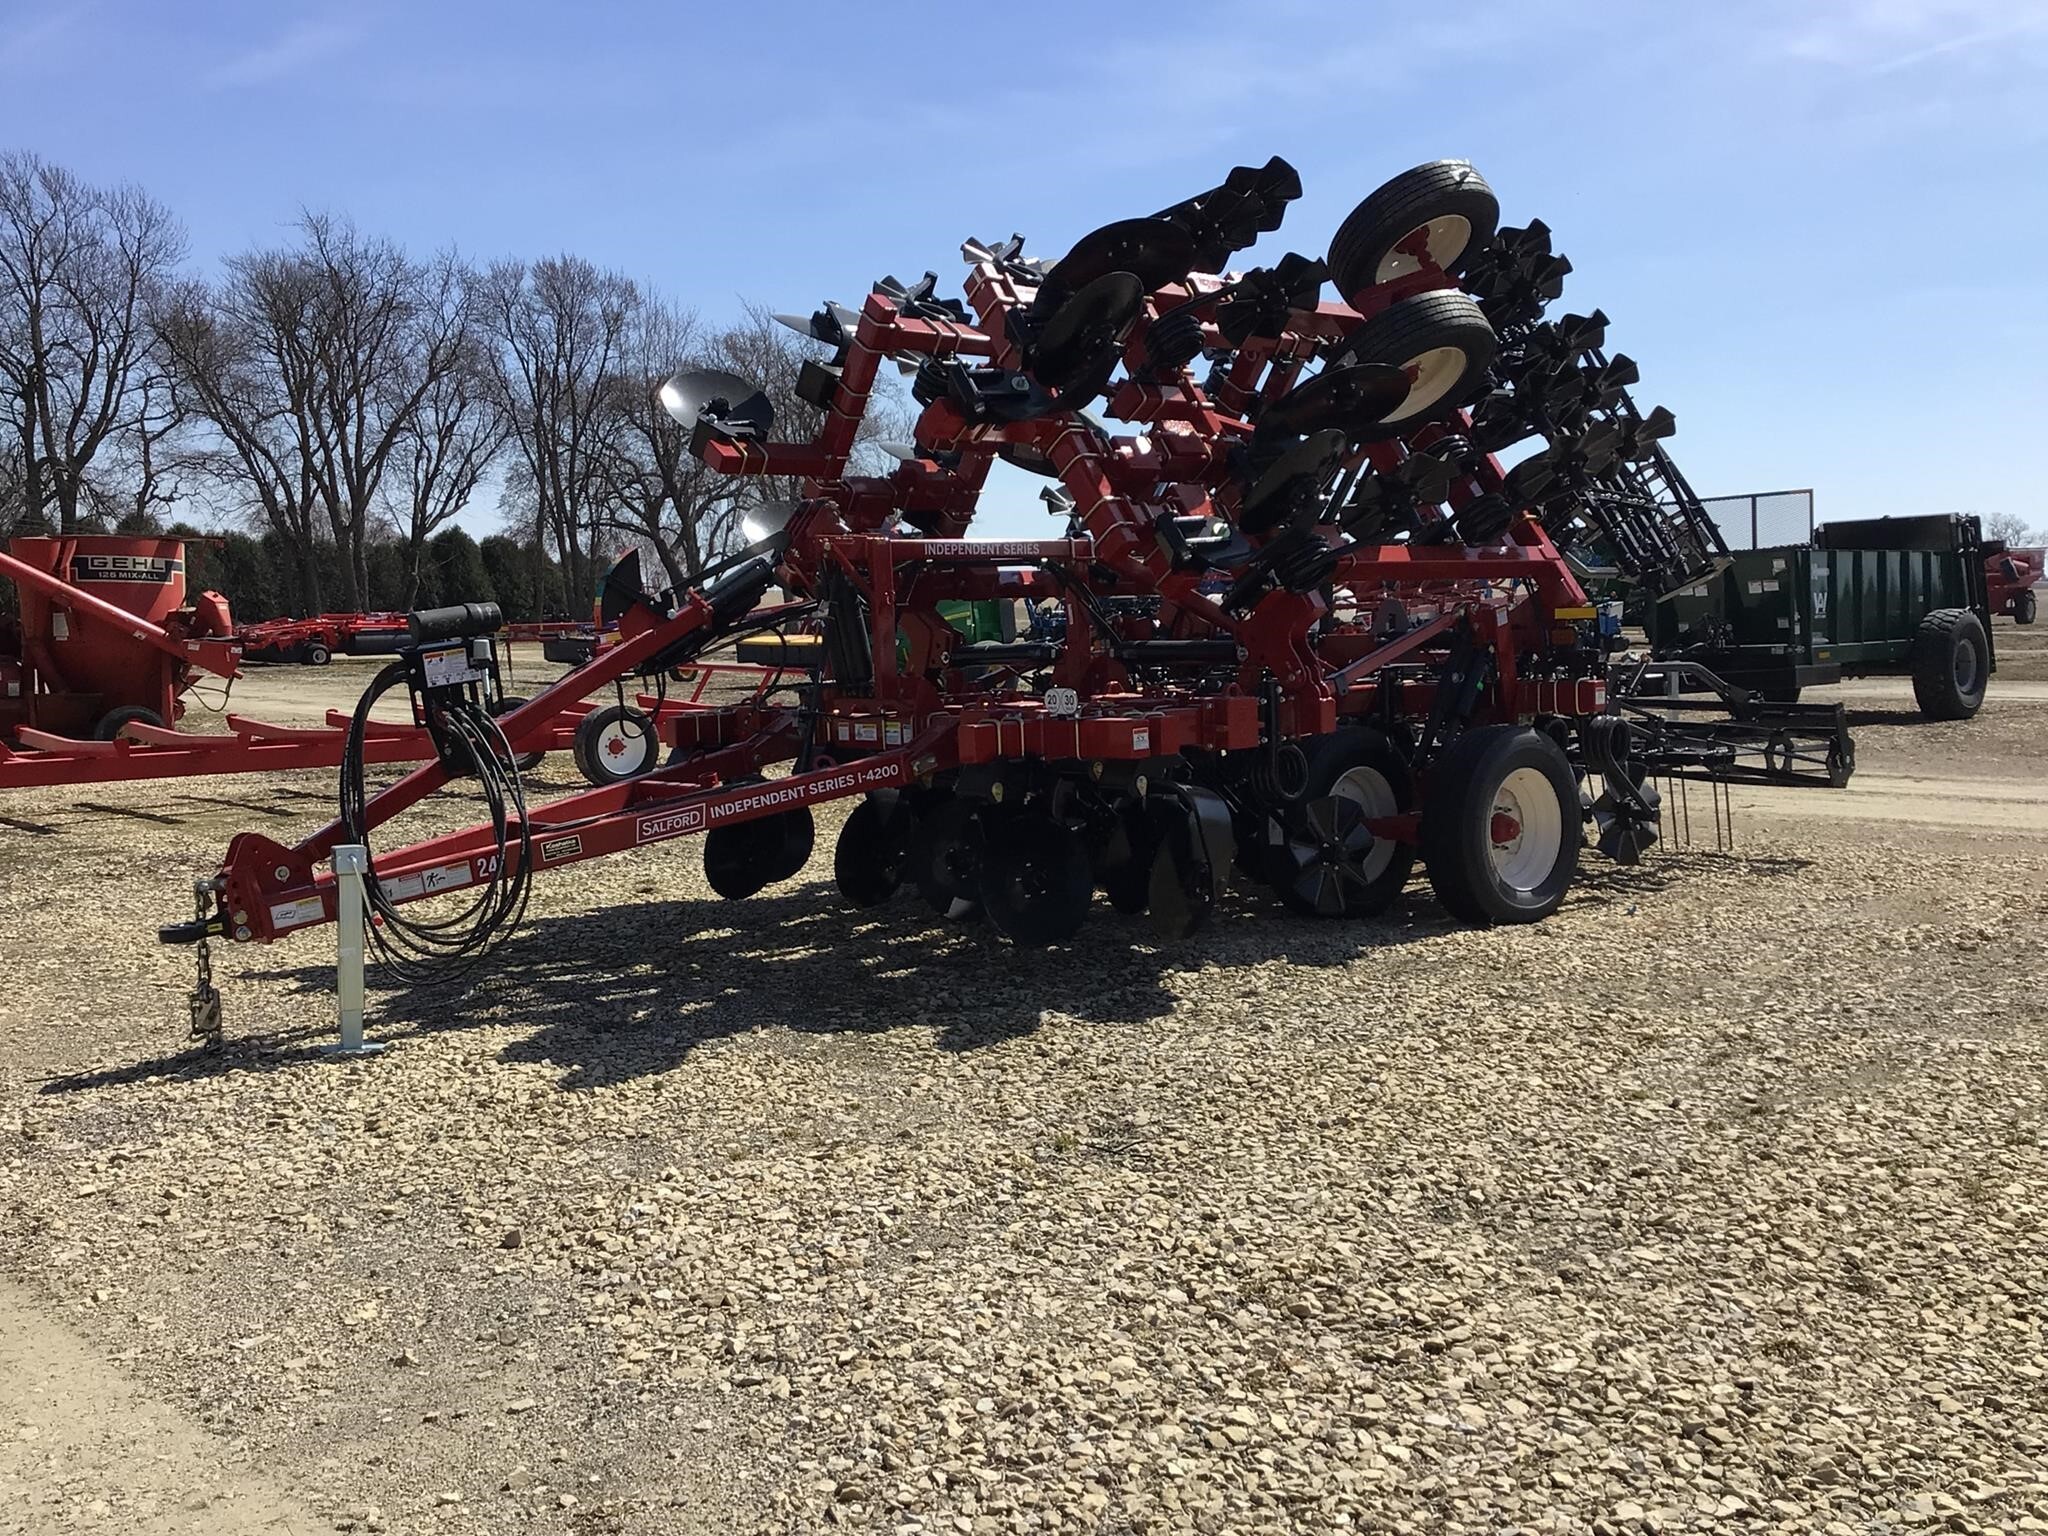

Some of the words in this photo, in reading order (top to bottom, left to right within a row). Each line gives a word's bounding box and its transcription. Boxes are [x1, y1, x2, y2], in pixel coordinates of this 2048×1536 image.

[924, 542, 1000, 556] INDEPENDENT
[1003, 542, 1040, 556] SERIES
[90, 557, 164, 571] GEHL
[1047, 694, 1057, 705] 20
[1064, 694, 1074, 706] 30
[709, 786, 806, 819] INDEPENDENT
[808, 774, 856, 796] SERIES
[857, 763, 899, 785] I-4200
